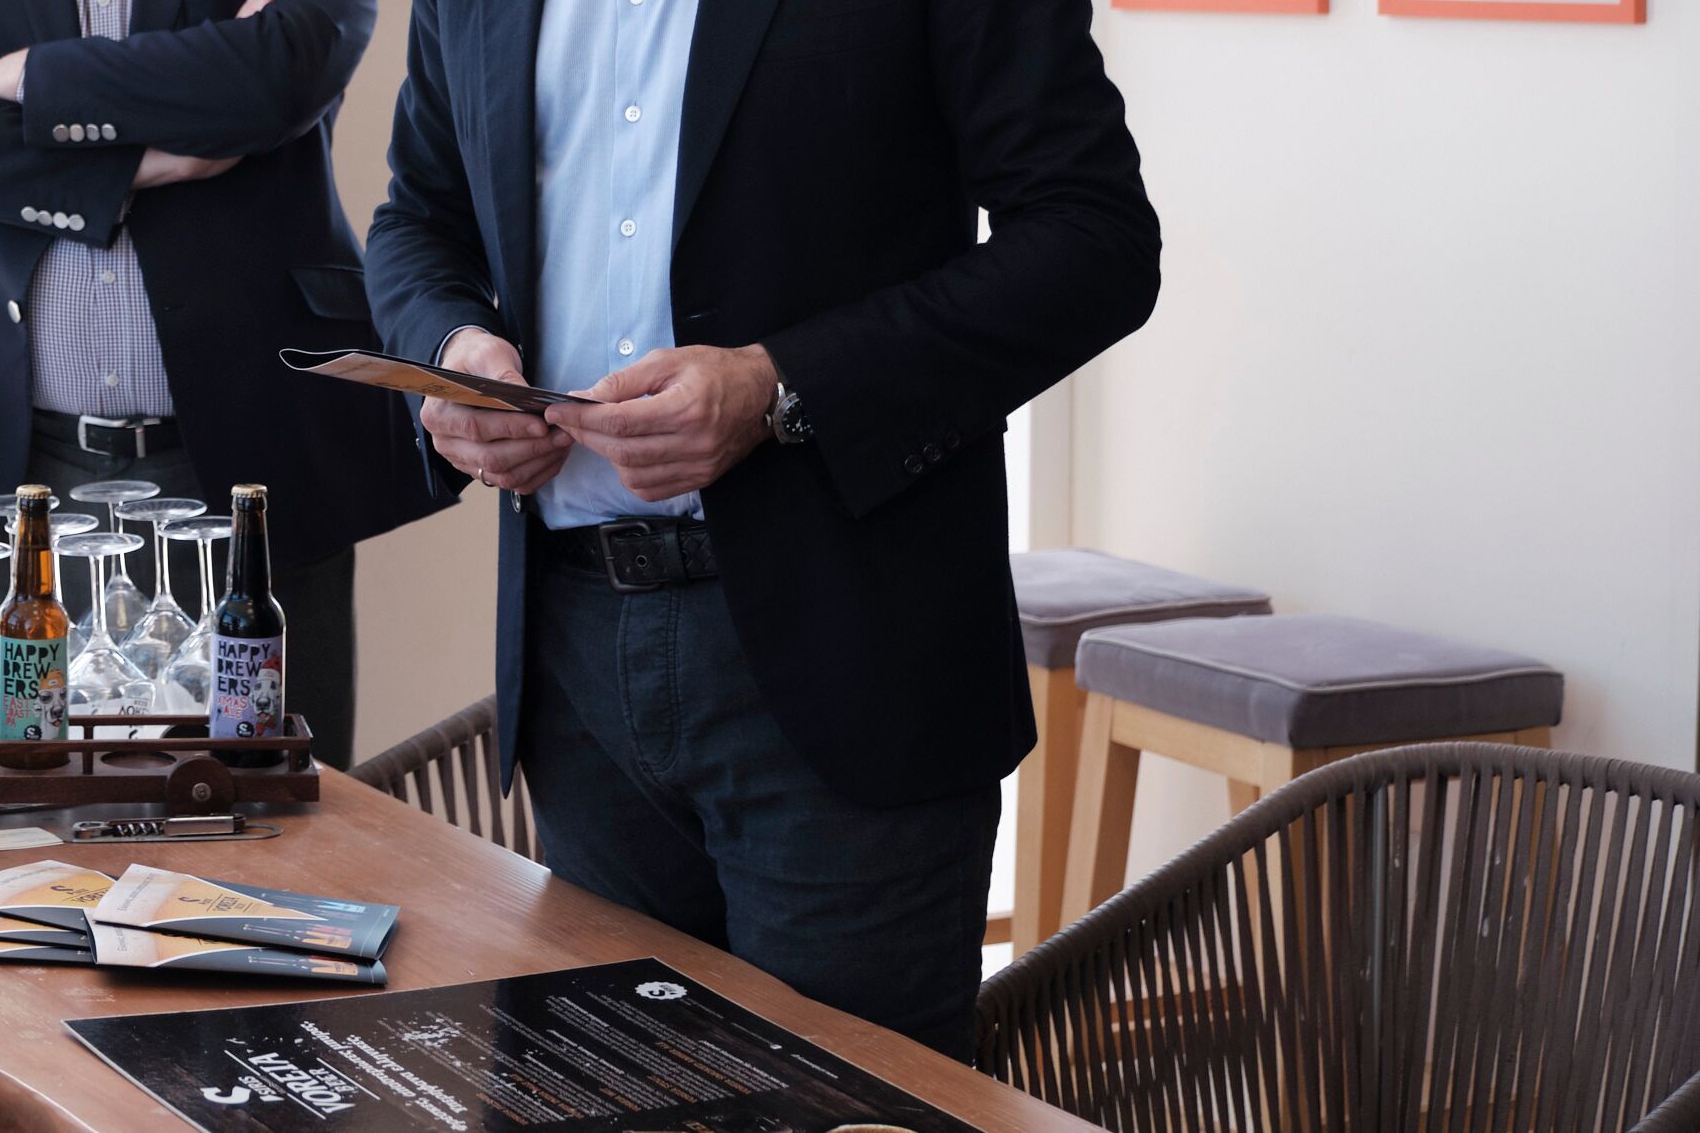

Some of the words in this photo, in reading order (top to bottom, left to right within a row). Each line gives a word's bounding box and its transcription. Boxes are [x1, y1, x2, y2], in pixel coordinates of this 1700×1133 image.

[4, 642, 60, 664] HAPPY
[218, 640, 270, 661] HAPPY
[3, 660, 51, 679] BREW
[217, 657, 262, 677] BREW
[4, 678, 40, 699] ERS
[217, 675, 251, 696] ERS
[248, 1052, 356, 1114] VOREIA
[308, 1067, 355, 1094] BEER
